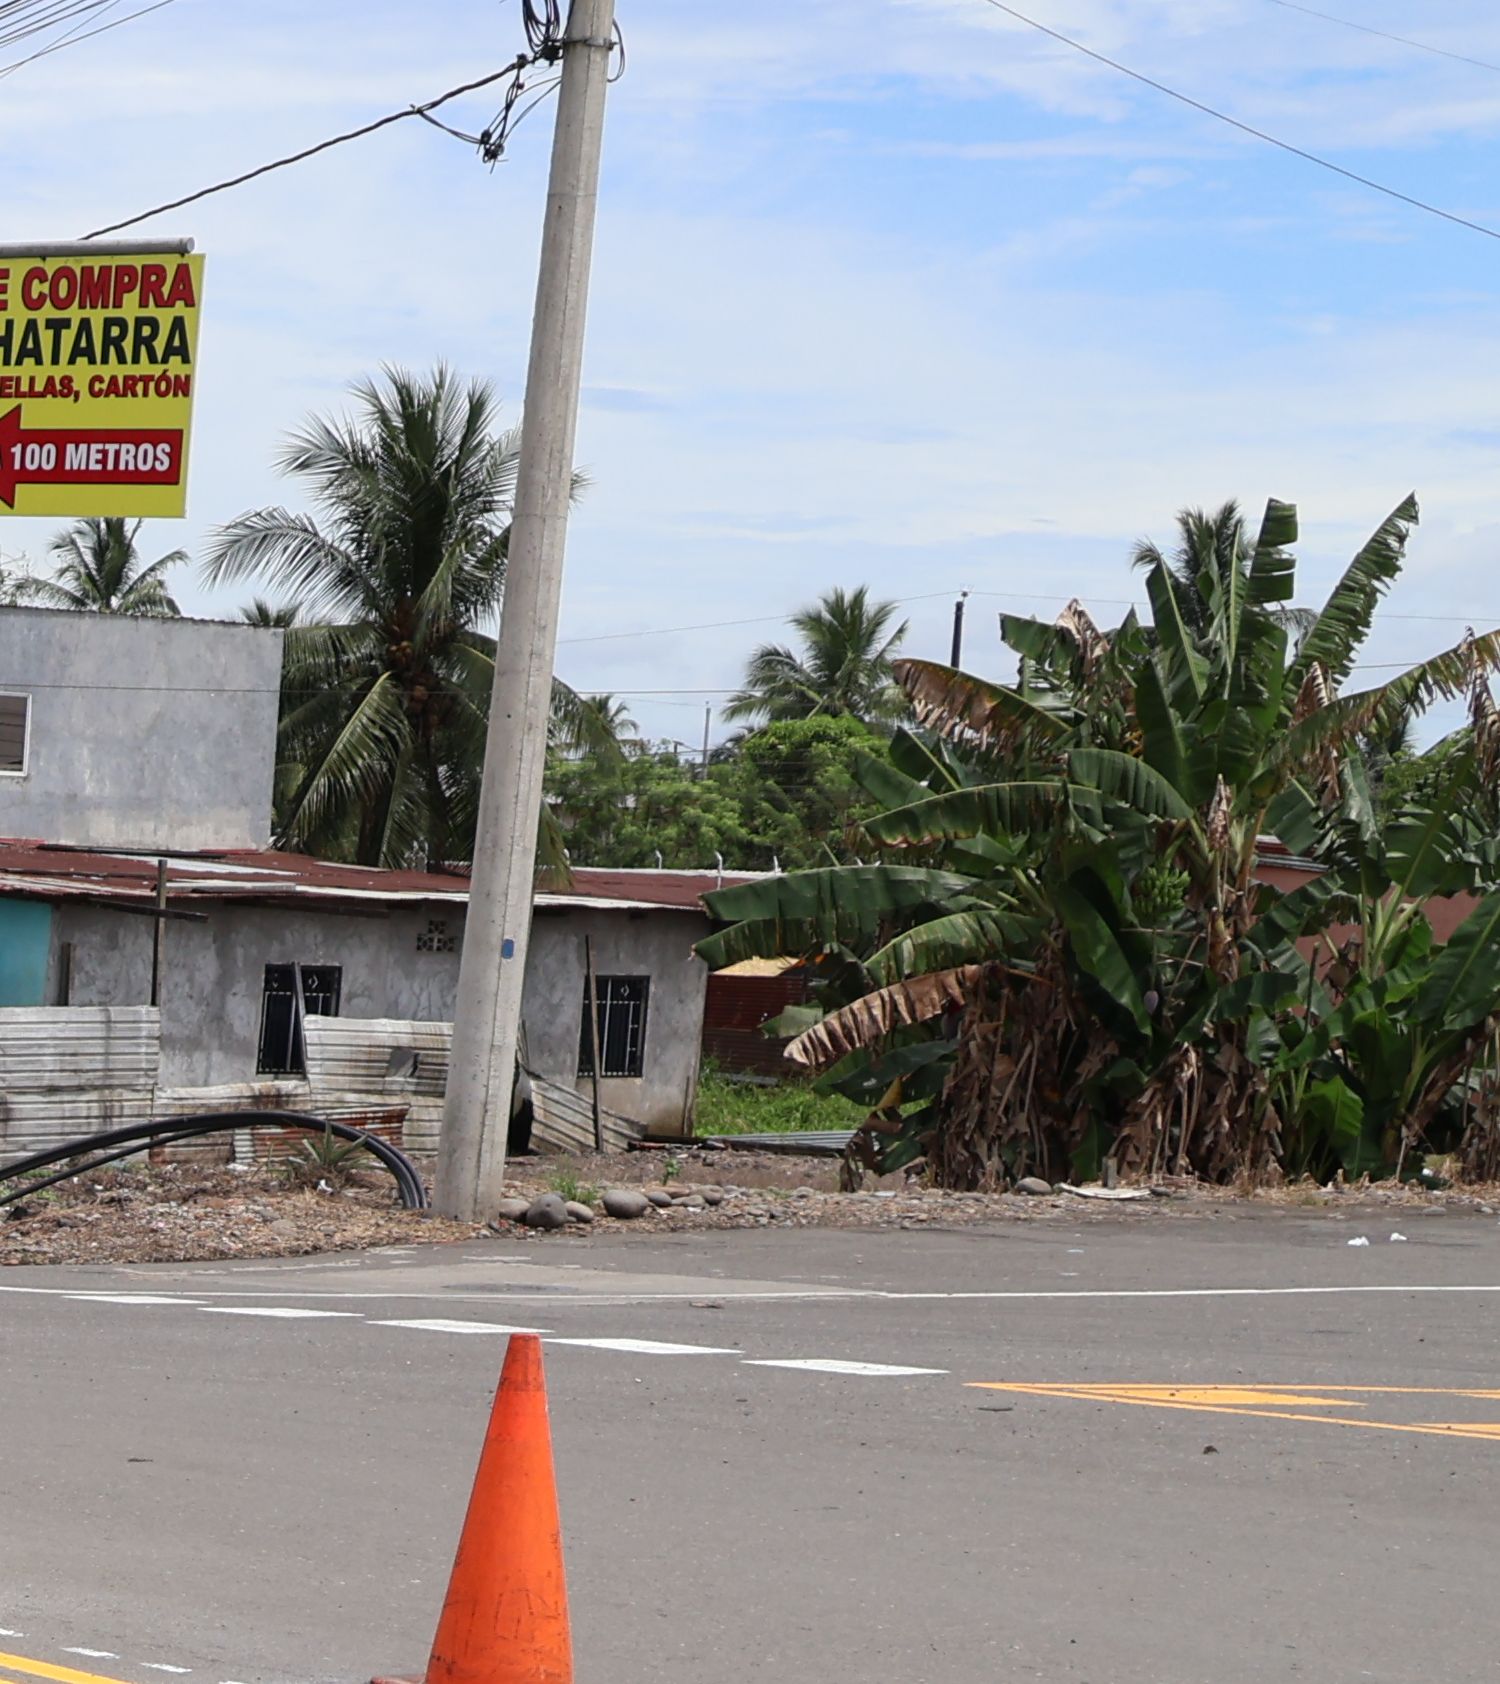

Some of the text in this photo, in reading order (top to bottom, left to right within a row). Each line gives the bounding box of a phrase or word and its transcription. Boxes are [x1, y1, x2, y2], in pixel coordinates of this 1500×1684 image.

[21, 263, 196, 311] COMPRA
[88, 369, 191, 398] CARTÓN
[10, 443, 56, 470] 100
[64, 442, 171, 471] METROS
